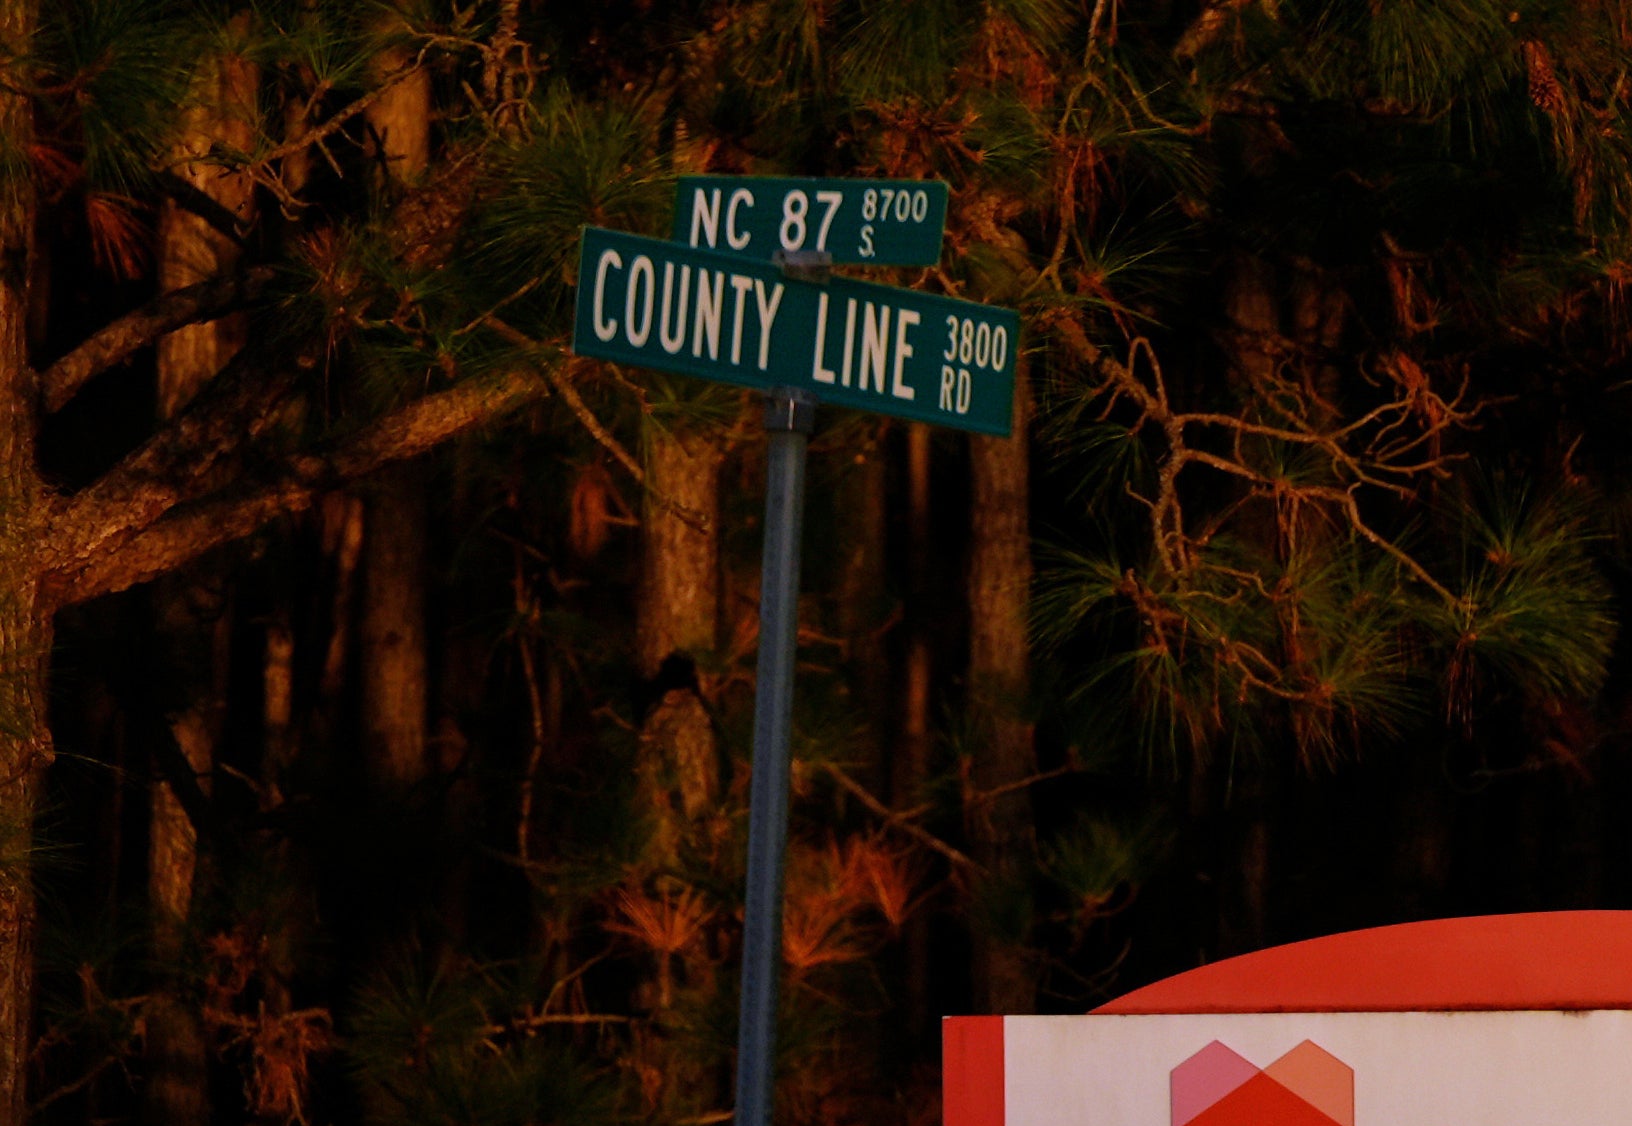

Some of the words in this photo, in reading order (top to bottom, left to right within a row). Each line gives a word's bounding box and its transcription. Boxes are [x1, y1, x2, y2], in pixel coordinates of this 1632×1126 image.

[690, 188, 755, 250] NC
[779, 190, 842, 251] 87
[862, 188, 928, 223] 8700
[593, 250, 785, 370] COUNTY
[812, 291, 921, 400] LINE
[942, 315, 1007, 372] 3800
[938, 365, 972, 414] RD
